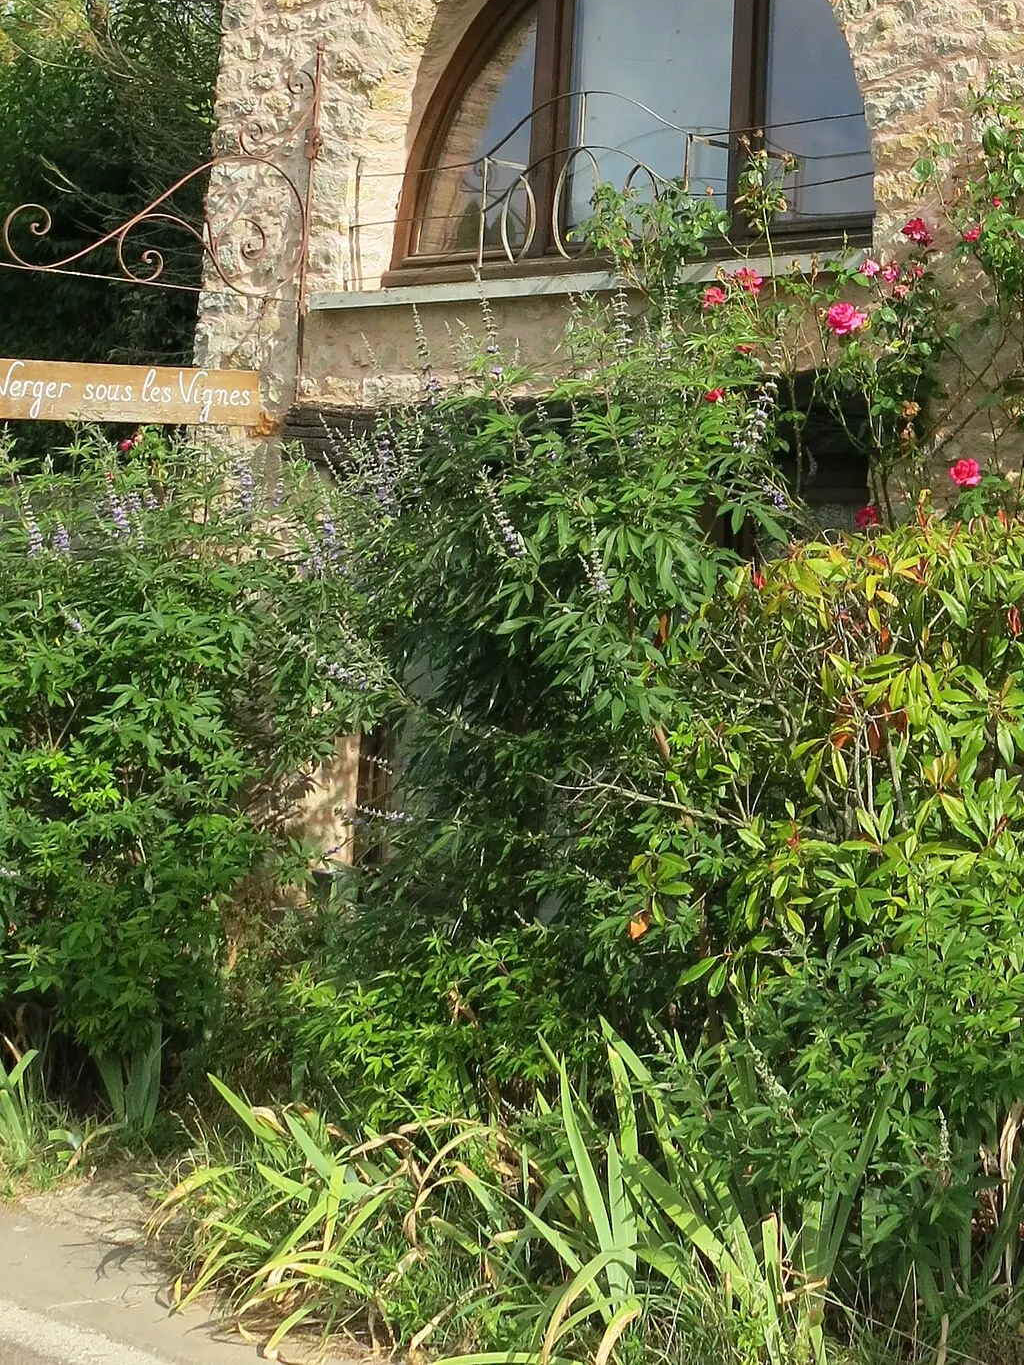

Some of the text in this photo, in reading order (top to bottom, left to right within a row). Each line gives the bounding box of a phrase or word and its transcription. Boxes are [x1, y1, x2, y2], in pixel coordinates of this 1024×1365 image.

[82, 383, 132, 402] sous
[141, 368, 172, 402] les
[178, 370, 250, 423] Vignes
